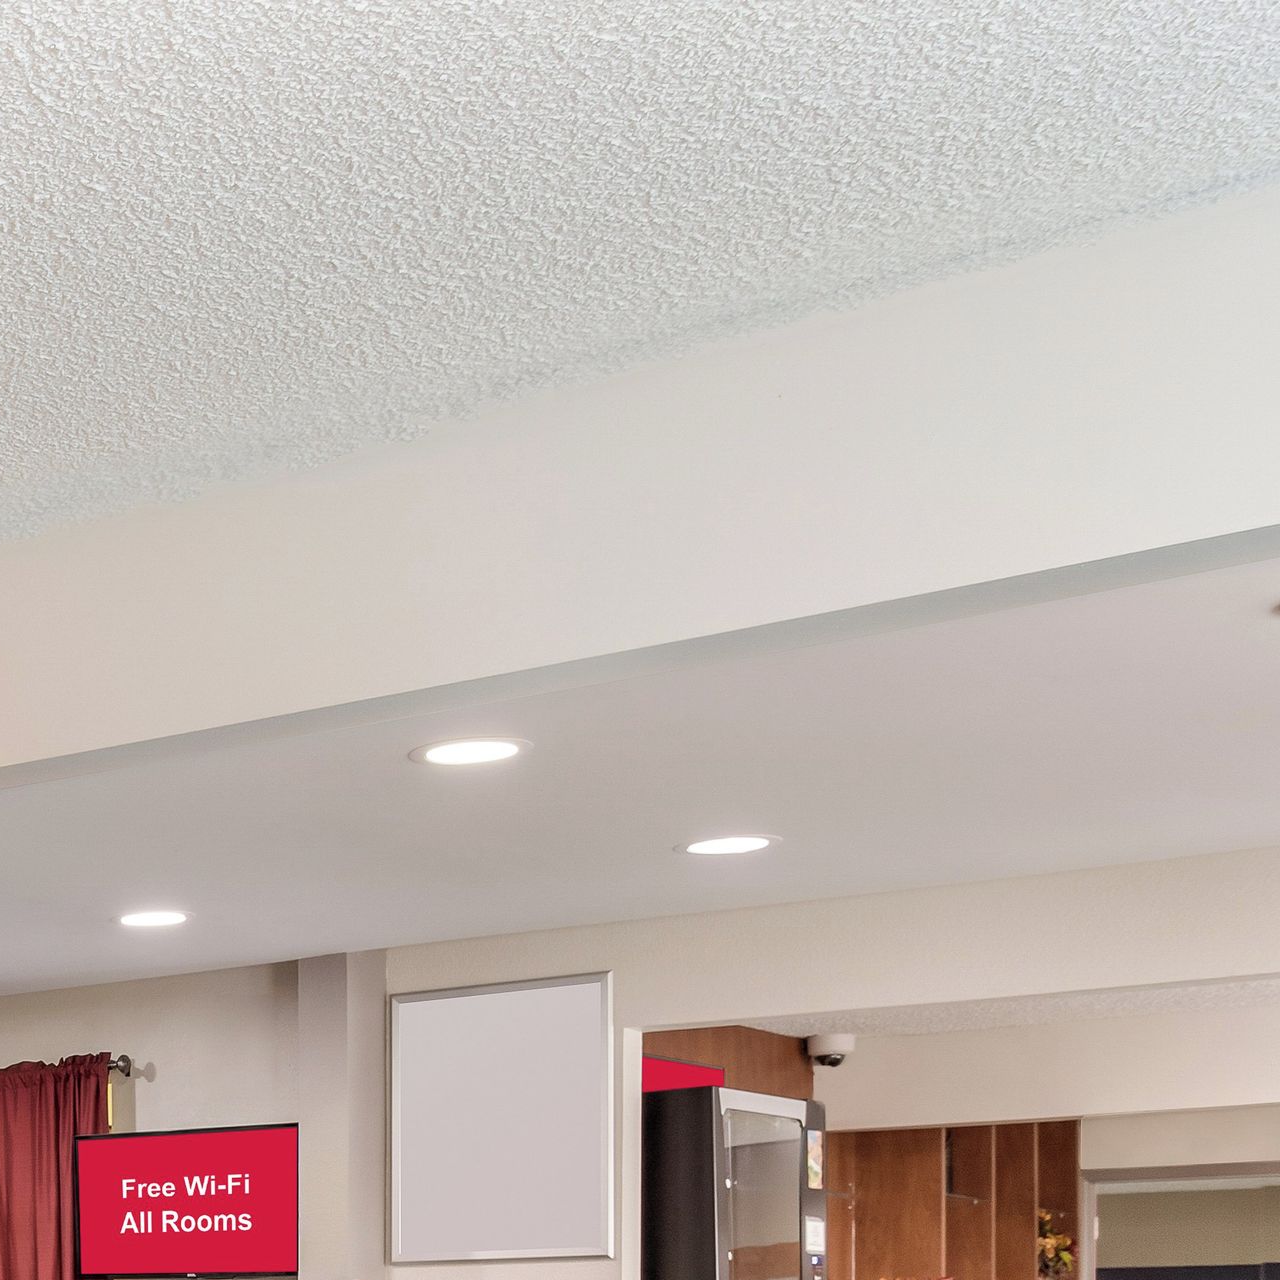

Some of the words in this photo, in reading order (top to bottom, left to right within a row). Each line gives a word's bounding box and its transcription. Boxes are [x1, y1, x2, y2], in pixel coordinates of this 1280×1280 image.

[121, 1178, 177, 1199] Free
[183, 1173, 250, 1197] Wi-Fi
[119, 1210, 153, 1234] All
[161, 1209, 253, 1233] Rooms
